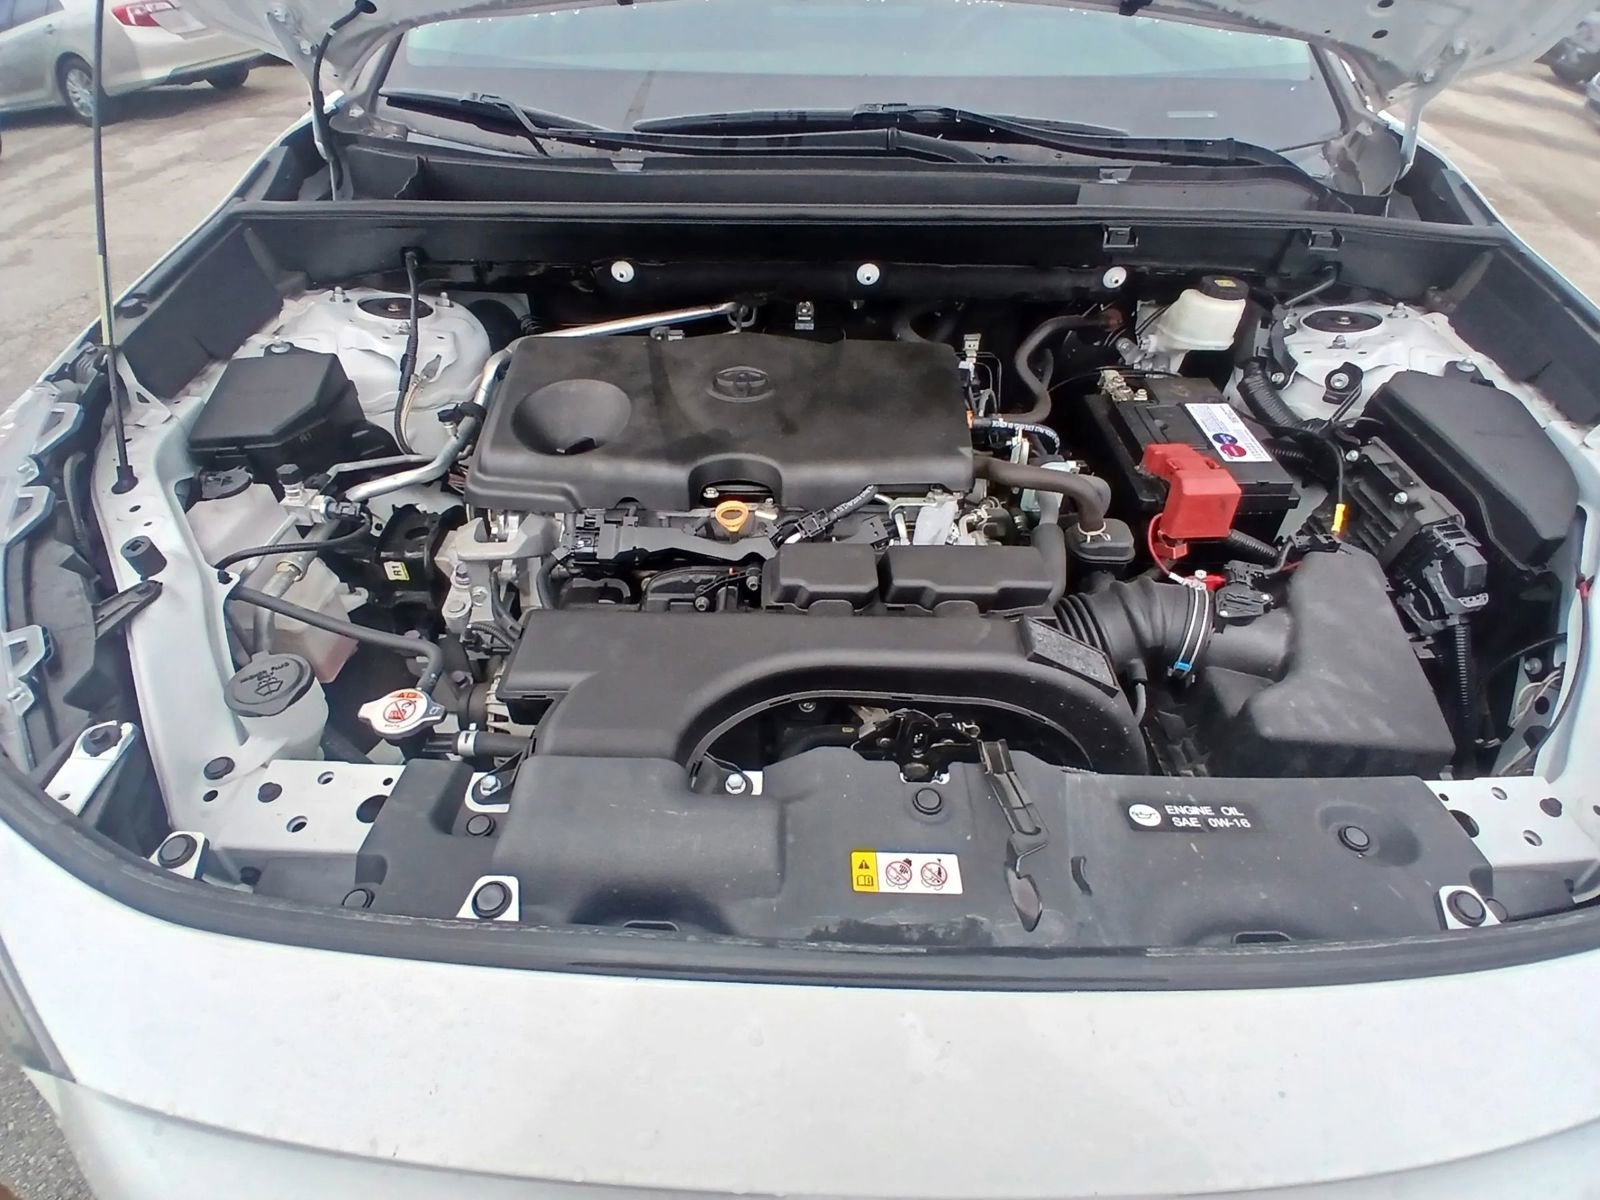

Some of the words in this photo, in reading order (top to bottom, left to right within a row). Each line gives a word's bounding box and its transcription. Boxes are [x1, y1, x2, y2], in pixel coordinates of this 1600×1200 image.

[1164, 804, 1215, 816] ENGINE
[1220, 806, 1245, 816] OIL
[1171, 816, 1202, 828] SAE
[1207, 817, 1252, 829] 0W-16
